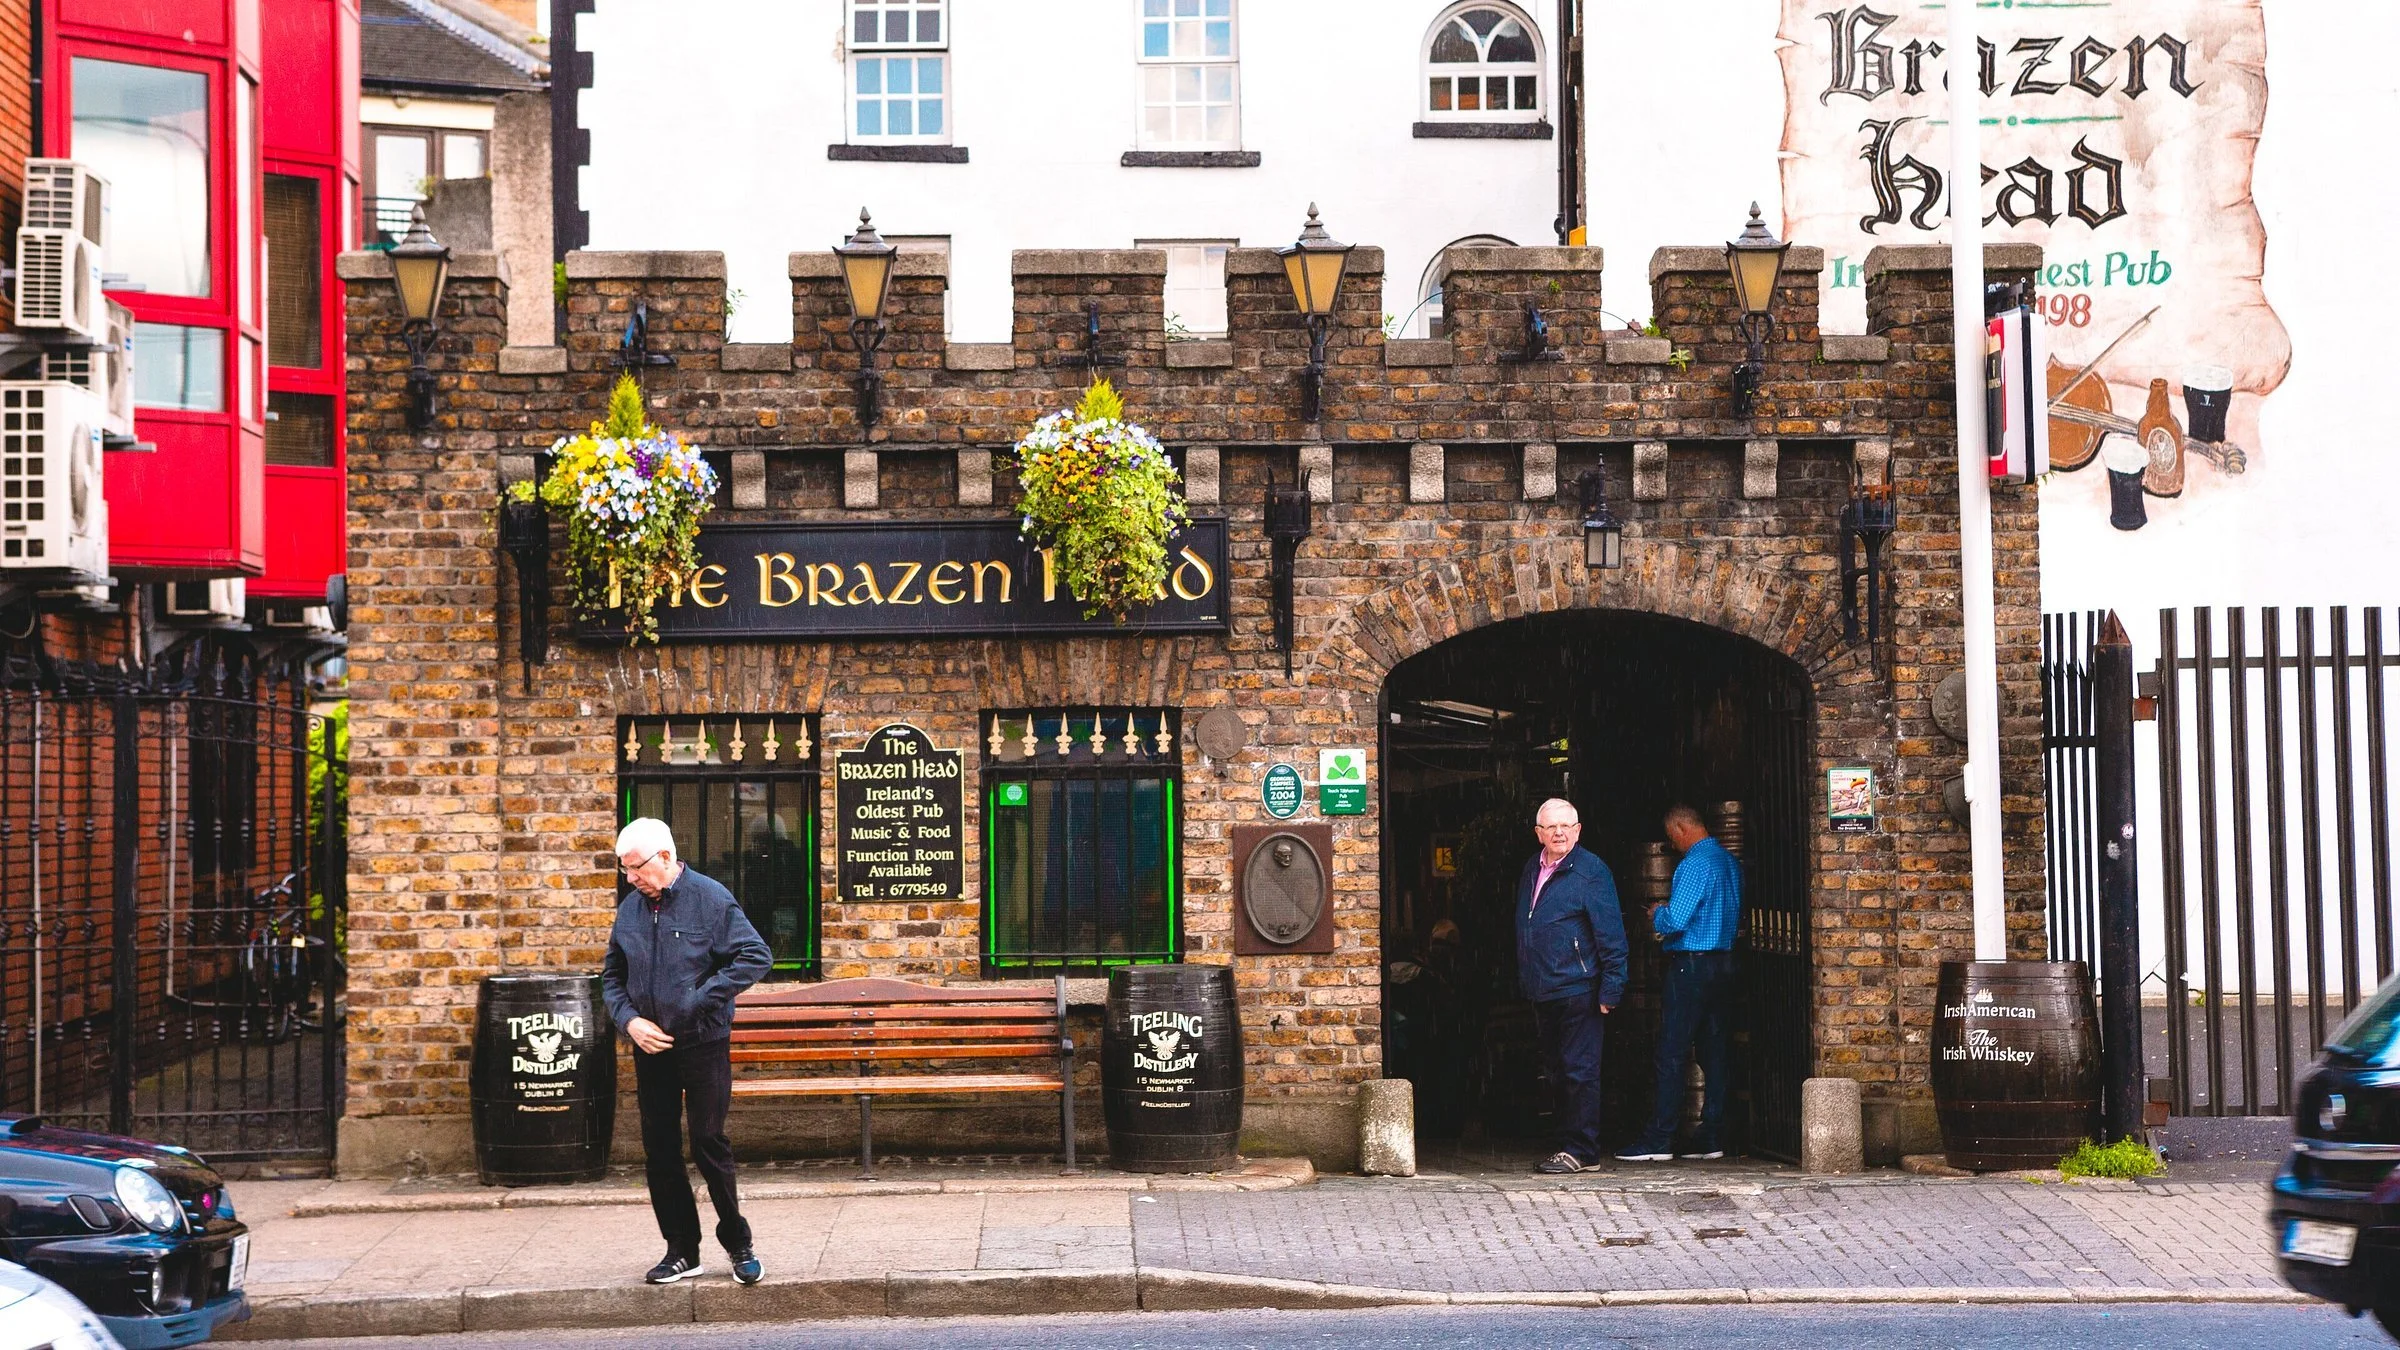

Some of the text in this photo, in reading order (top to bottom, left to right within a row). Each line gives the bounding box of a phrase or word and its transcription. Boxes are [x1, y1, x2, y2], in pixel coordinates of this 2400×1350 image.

[2104, 250, 2172, 287] Pub
[882, 738, 918, 756] The
[866, 786, 934, 801] Ireland's
[1270, 791, 1295, 800] 2004
[856, 803, 944, 819] Oldest Pub
[851, 825, 951, 840] Music & Food
[846, 849, 955, 862] Function Room
[868, 864, 933, 878] Available
[890, 883, 947, 896] 6779549
[507, 1012, 584, 1040] TEELING
[1130, 1011, 1203, 1037] TEELING
[1969, 1029, 1998, 1046] The
[1943, 1046, 2034, 1065] Irish Whiskey
[1177, 1084, 1184, 1093] 8
